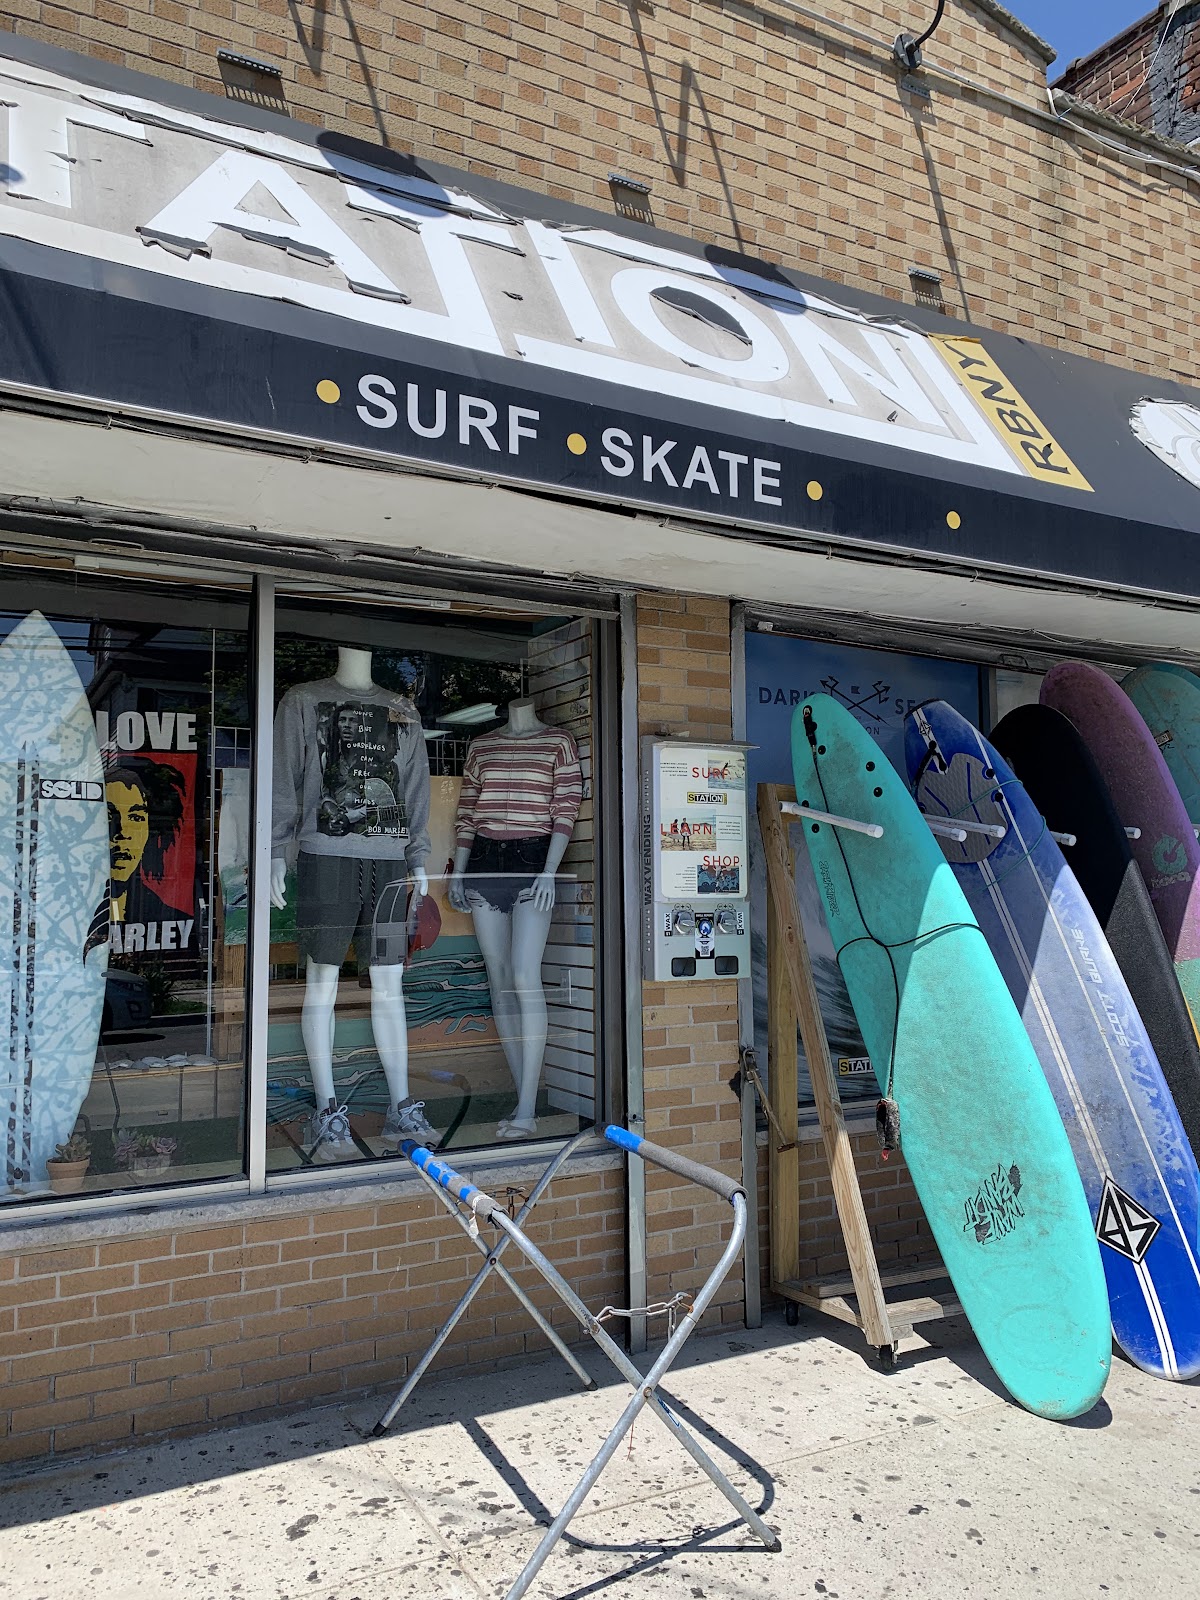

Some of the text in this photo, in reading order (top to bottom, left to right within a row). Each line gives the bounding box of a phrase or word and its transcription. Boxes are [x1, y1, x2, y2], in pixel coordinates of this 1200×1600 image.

[944, 342, 1071, 475] RBNY
[356, 374, 782, 506] SURF SKATE
[96, 710, 198, 751] LOVE
[358, 725, 373, 733] BUT
[41, 780, 103, 800] SOLID
[660, 823, 712, 835] LEARN
